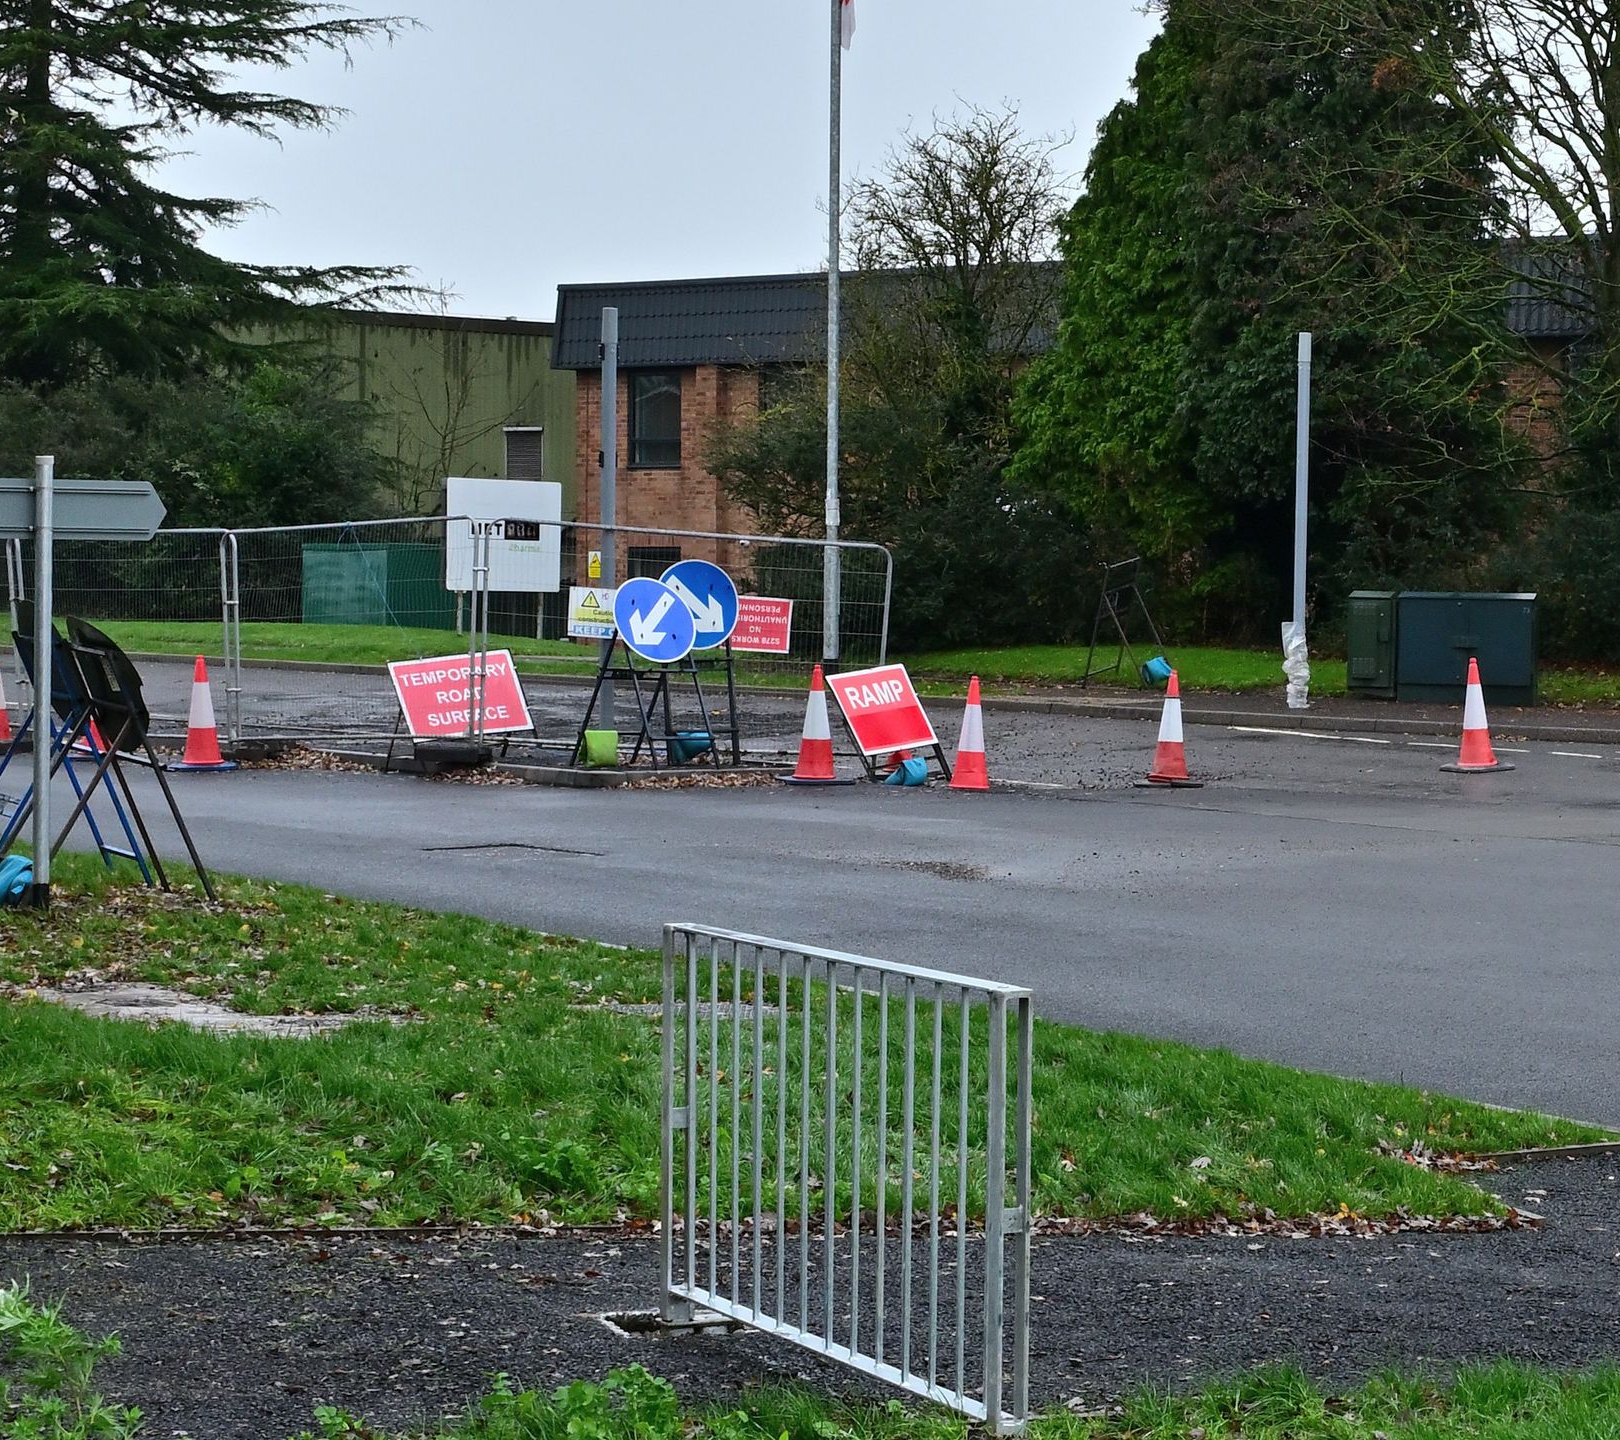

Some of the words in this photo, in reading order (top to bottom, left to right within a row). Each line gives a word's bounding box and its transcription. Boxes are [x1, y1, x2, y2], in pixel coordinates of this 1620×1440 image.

[574, 625, 605, 636] KEEP
[398, 663, 507, 687] TEMPORARY
[436, 687, 487, 704] ROAD
[844, 679, 904, 710] RAMP
[427, 705, 510, 727] SURFACE
